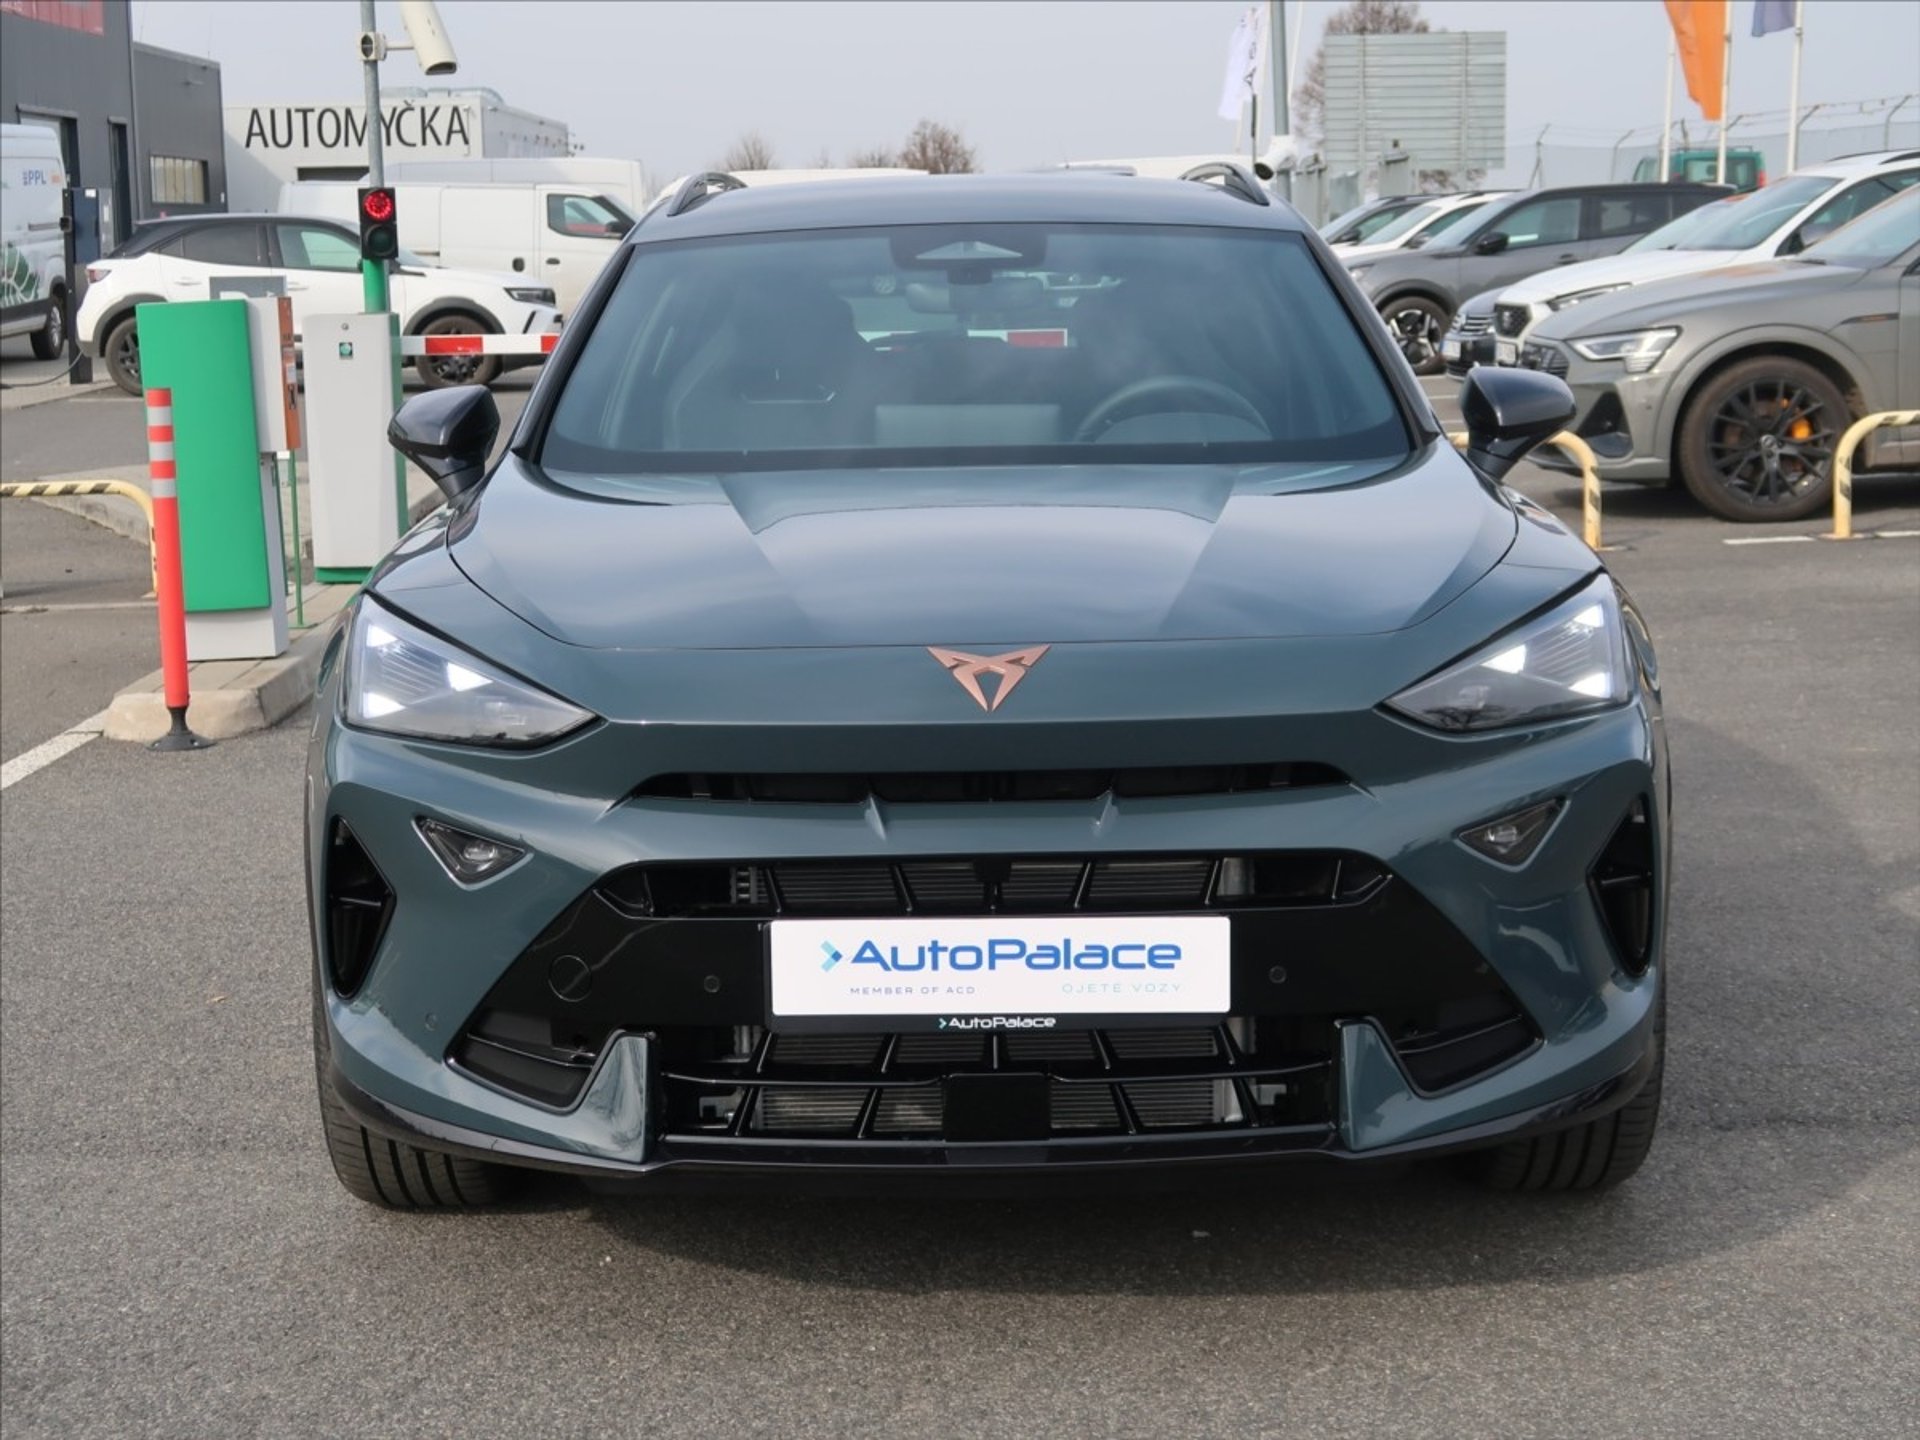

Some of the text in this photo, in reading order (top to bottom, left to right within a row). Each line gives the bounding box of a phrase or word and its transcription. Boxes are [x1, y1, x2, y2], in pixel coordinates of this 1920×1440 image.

[245, 100, 469, 148] AUTOMYČKA
[28, 169, 47, 186] PPL
[851, 938, 1182, 972] AutoPalace
[850, 986, 976, 995] MEMBER OF ACD
[1131, 983, 1181, 993] VOZY
[948, 1016, 1056, 1029] AutoPalace
